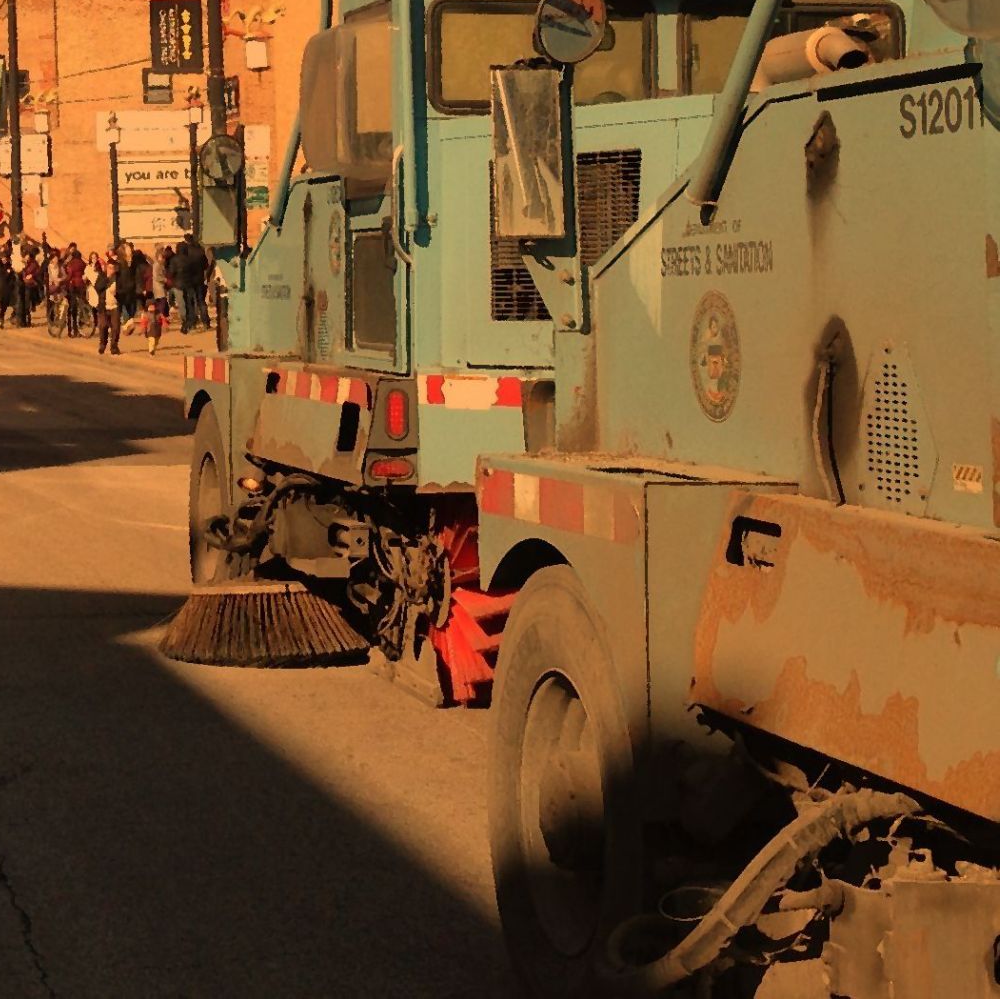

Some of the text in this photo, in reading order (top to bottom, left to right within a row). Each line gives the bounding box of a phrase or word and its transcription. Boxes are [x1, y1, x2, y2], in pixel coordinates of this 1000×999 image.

[124, 171, 151, 184] you
[155, 170, 180, 181] are
[660, 240, 774, 277] STREETS & SANITATION
